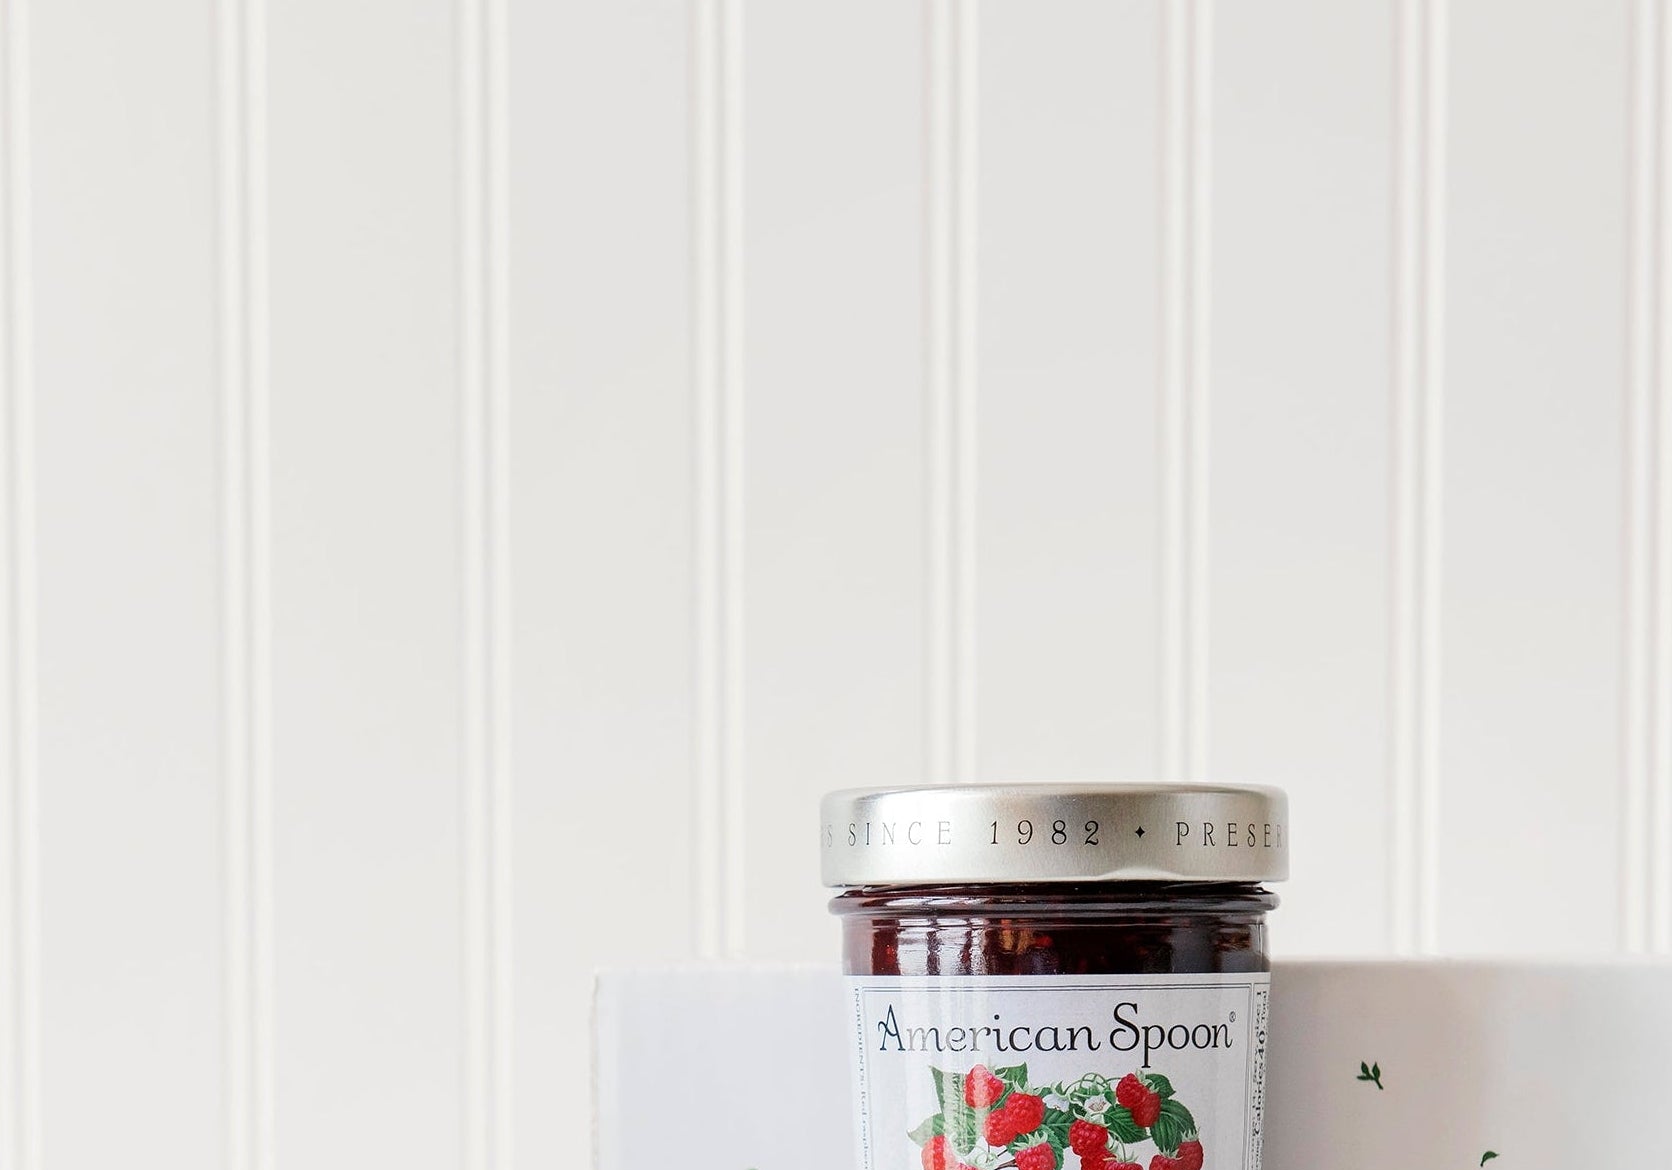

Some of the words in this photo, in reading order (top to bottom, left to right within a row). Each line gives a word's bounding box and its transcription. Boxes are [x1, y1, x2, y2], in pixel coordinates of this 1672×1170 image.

[847, 821, 951, 846] SINCE
[991, 820, 1100, 846] 1982
[878, 1004, 1101, 1051] American
